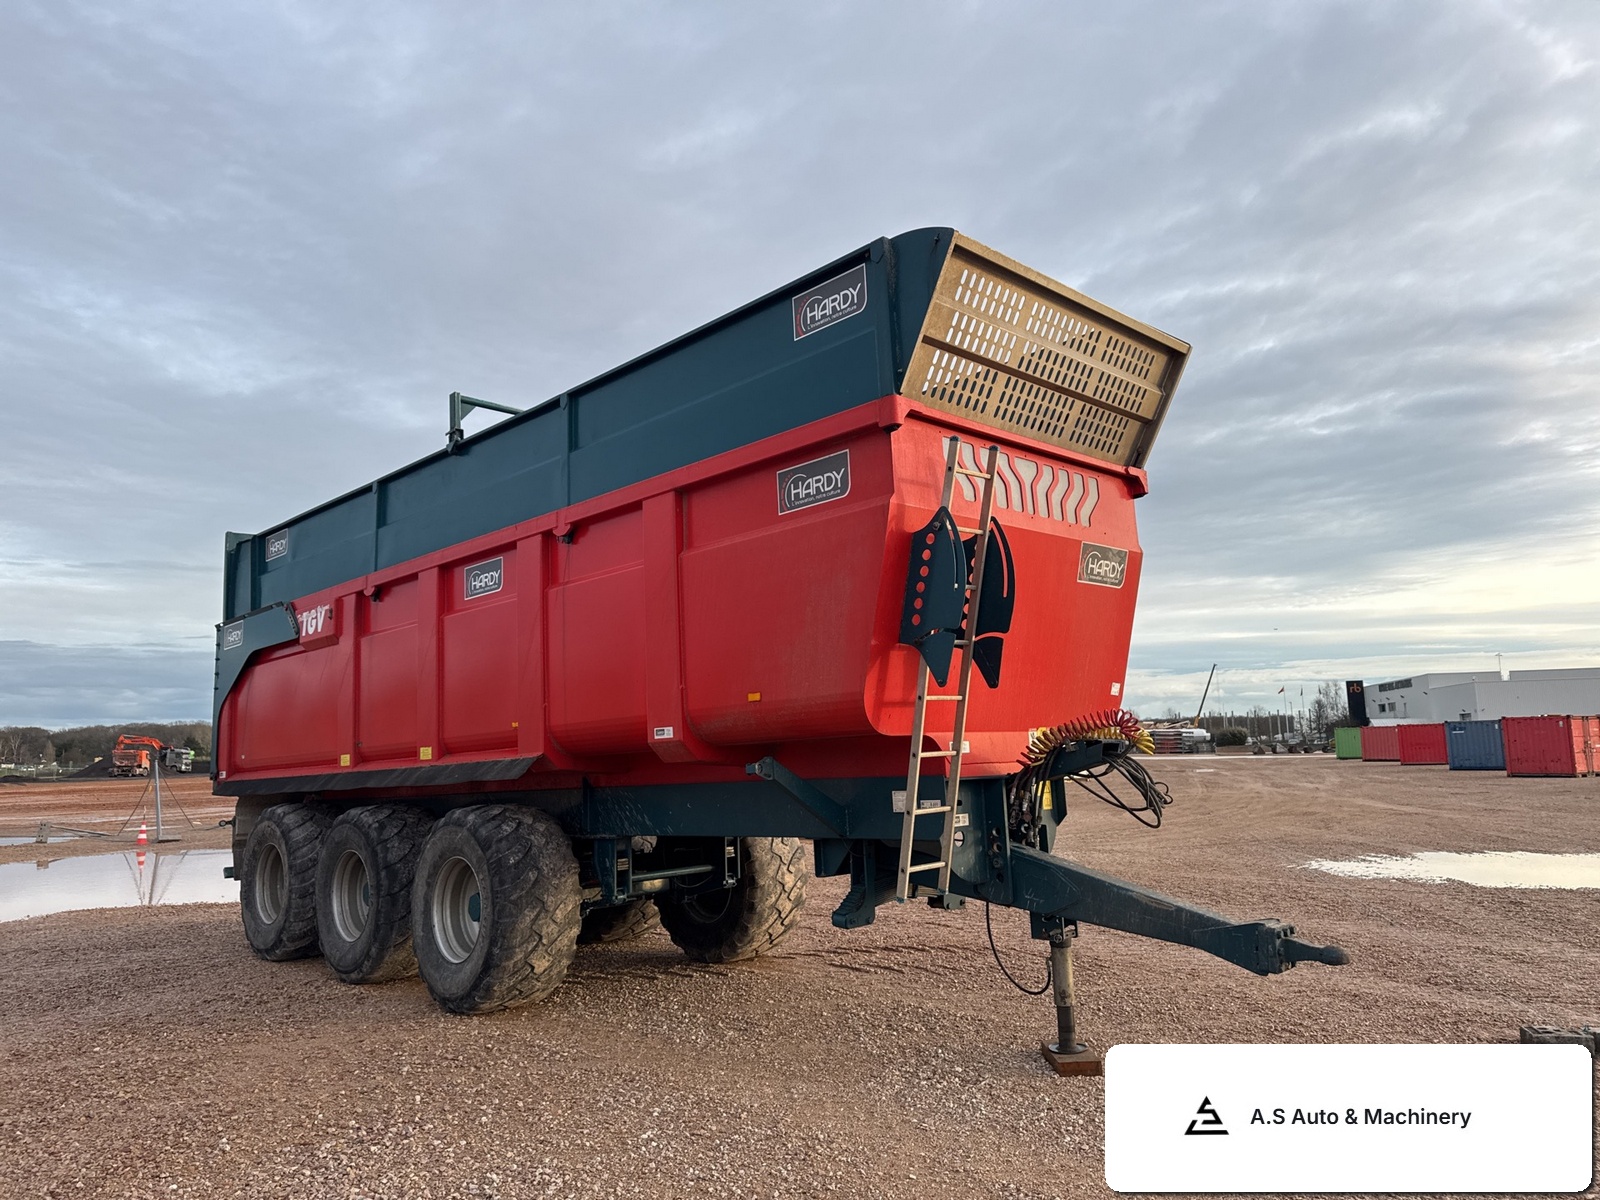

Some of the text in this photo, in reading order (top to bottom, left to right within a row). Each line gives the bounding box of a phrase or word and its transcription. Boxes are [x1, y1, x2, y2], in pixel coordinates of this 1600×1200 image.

[806, 282, 862, 325] HARDY
[790, 467, 846, 501] HARDY
[269, 537, 287, 554] HARDY
[1087, 557, 1125, 579] HARDY
[471, 569, 501, 591] HARDY
[297, 604, 330, 637] TGV
[1349, 682, 1362, 693] rb
